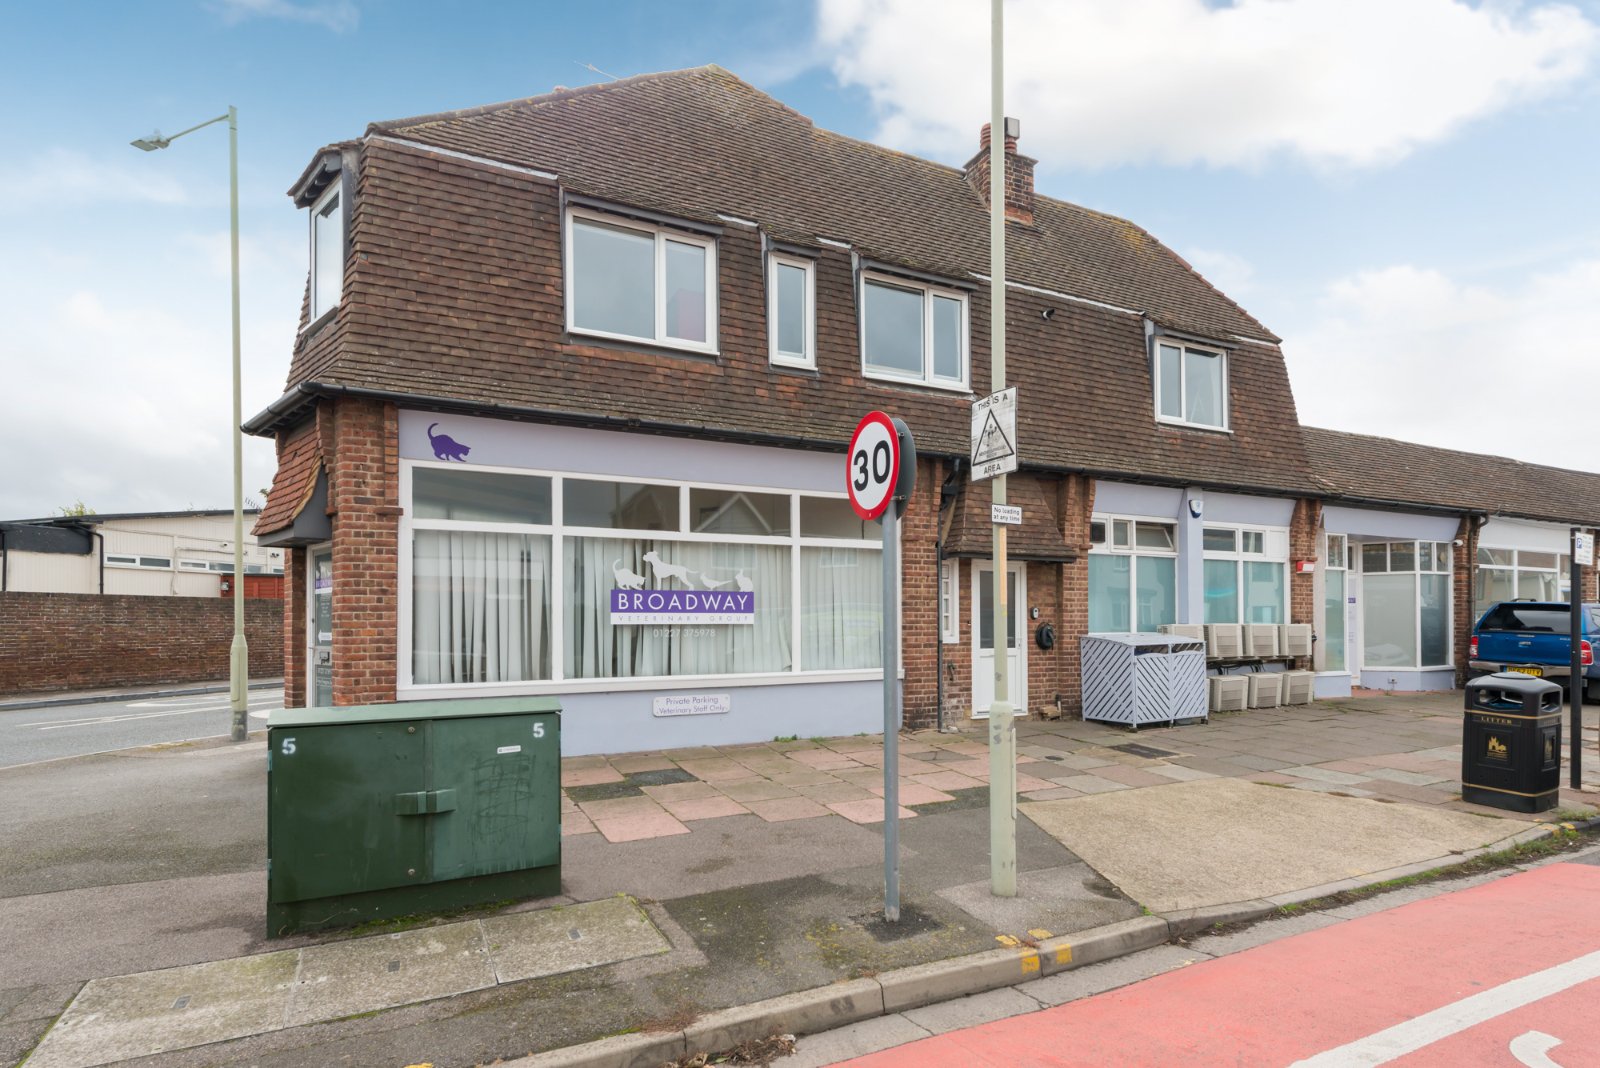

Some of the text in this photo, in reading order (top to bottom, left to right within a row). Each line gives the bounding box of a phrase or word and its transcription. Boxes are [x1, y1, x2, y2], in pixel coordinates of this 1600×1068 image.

[978, 393, 1008, 411] THIS IS A
[853, 440, 891, 492] 30
[984, 463, 1002, 475] AREA
[1002, 508, 1020, 516] loading
[618, 593, 748, 612] BROADWAY
[653, 628, 716, 638] 01227 375978
[666, 696, 719, 706] Private Parking
[658, 704, 726, 715] Veterinary Staff Only
[1481, 716, 1512, 725] LITTER
[532, 722, 544, 738] 5
[281, 738, 296, 755] 5
